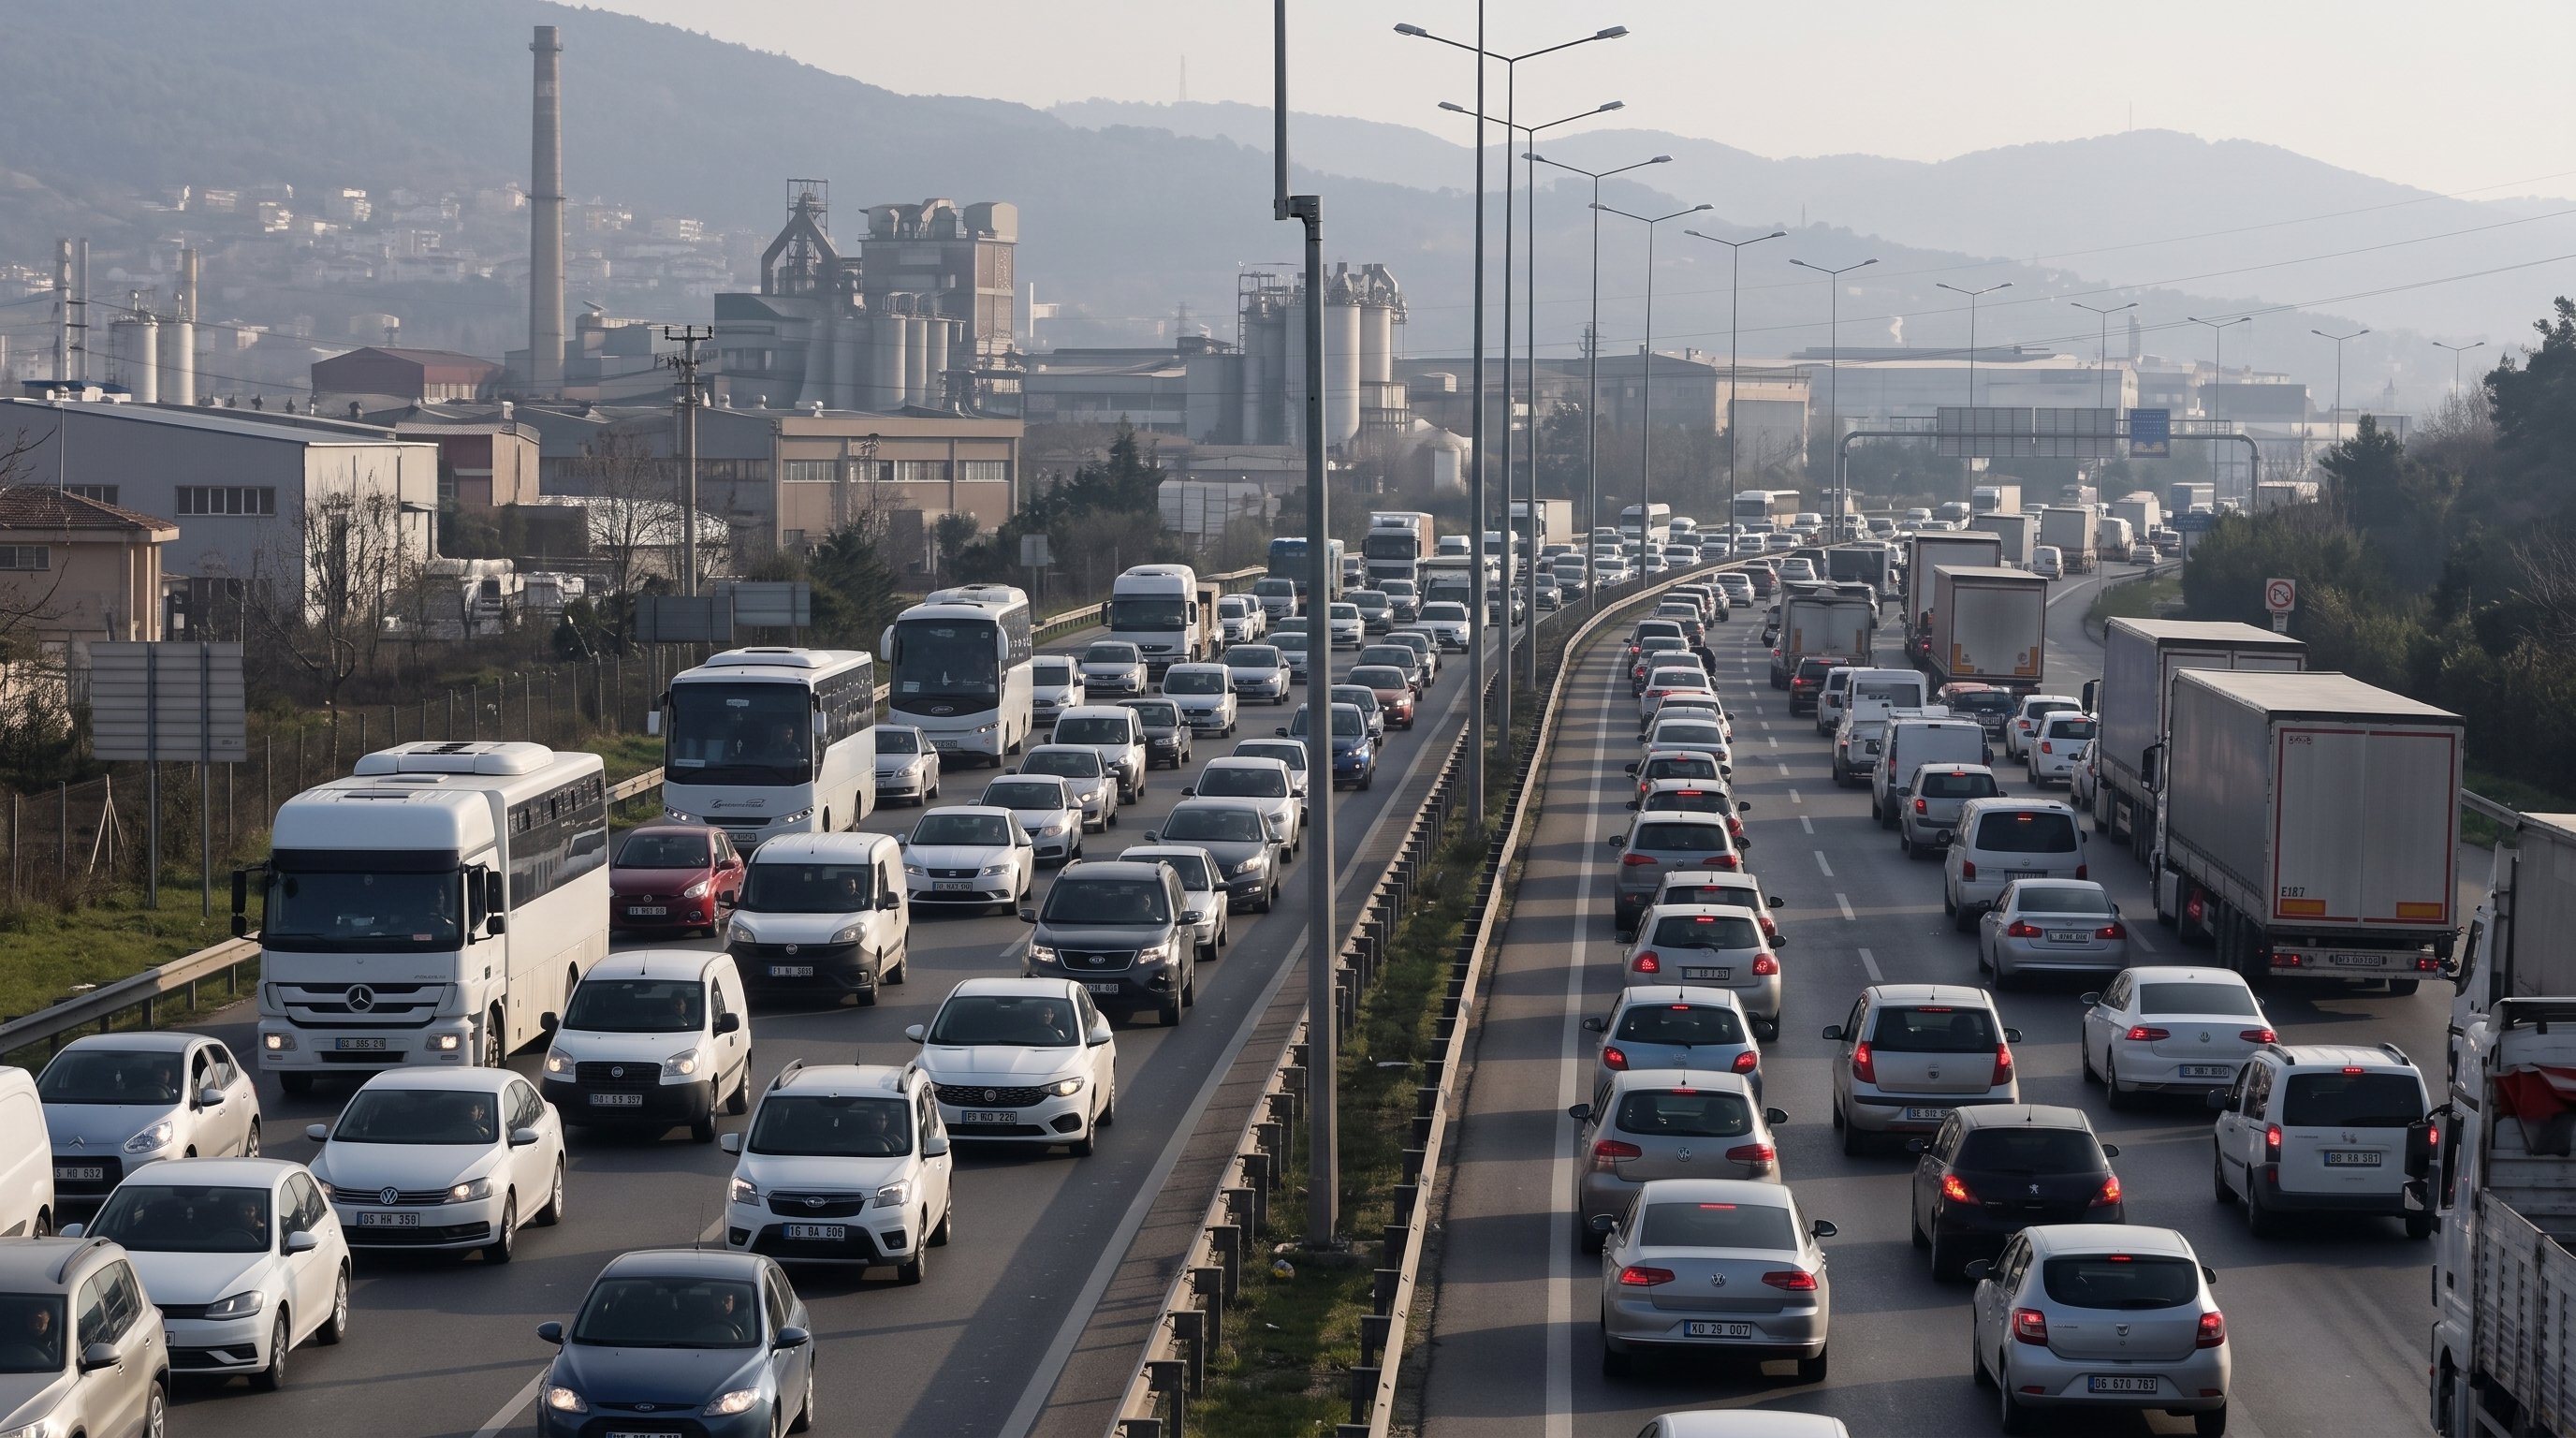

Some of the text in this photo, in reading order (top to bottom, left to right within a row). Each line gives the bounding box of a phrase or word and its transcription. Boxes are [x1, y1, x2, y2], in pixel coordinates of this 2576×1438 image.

[2280, 887, 2305, 898] E187
[83, 1168, 101, 1178] 632
[790, 1225, 801, 1237] 16
[1711, 1324, 1722, 1334] 29
[1730, 1325, 1749, 1335] 007
[2113, 1378, 2131, 1389] 670
